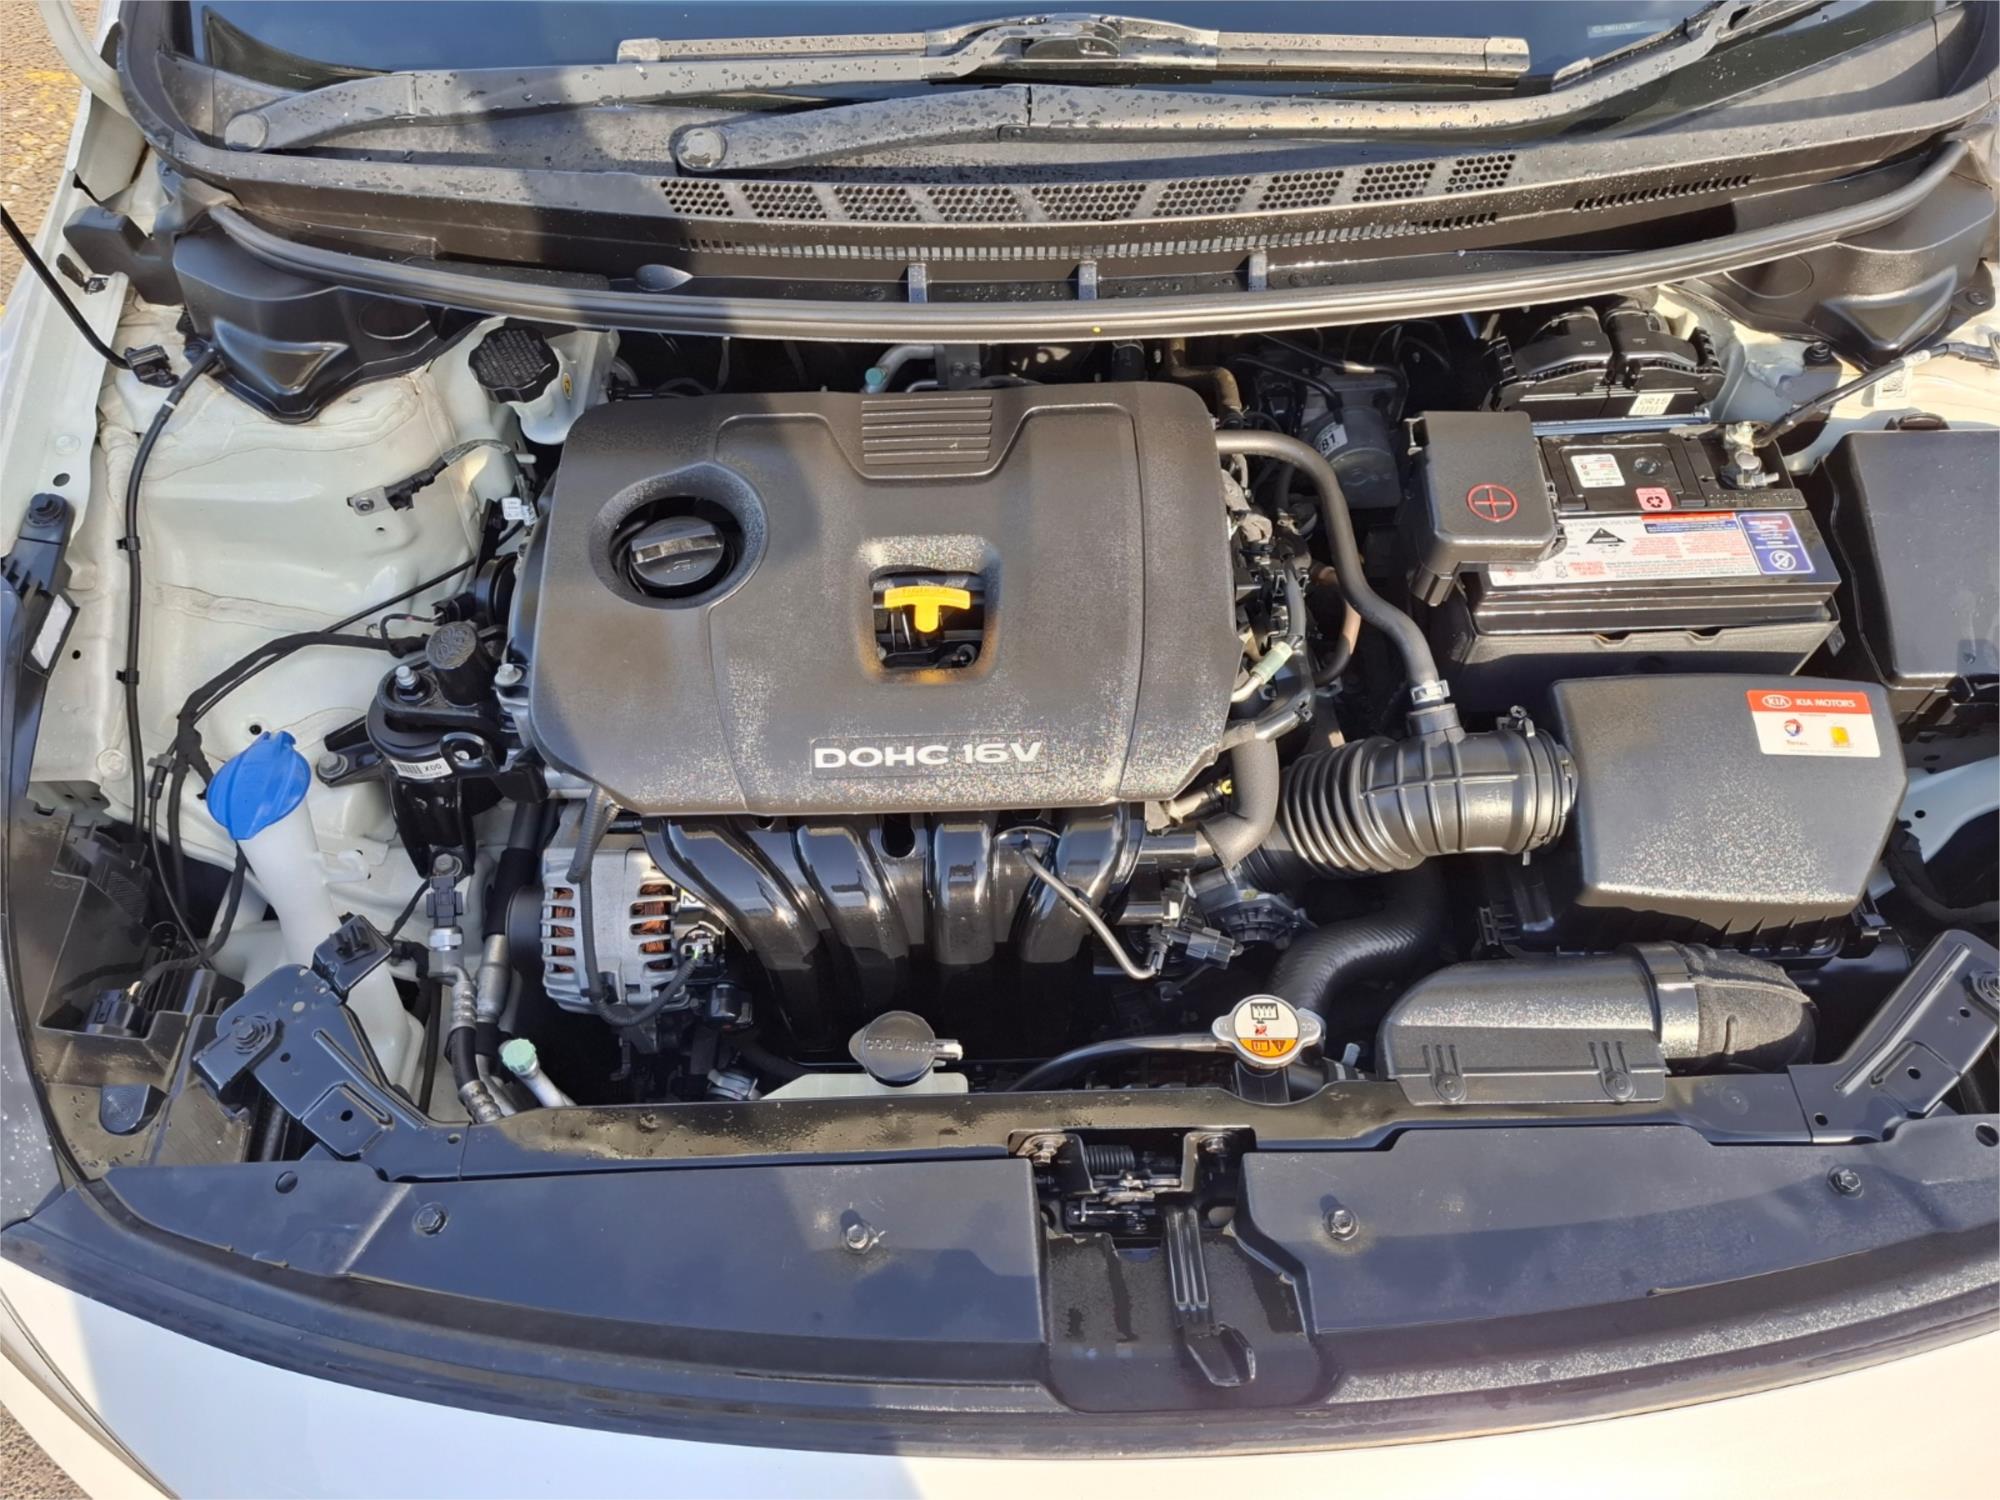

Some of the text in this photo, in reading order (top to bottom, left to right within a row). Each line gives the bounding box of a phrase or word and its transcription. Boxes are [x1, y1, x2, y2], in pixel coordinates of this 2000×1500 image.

[1765, 695, 1789, 708] KIA
[1795, 698, 1857, 708] KIA MOTORS
[815, 742, 1042, 768] DOHC 16V
[866, 1039, 935, 1052] COOLANT
